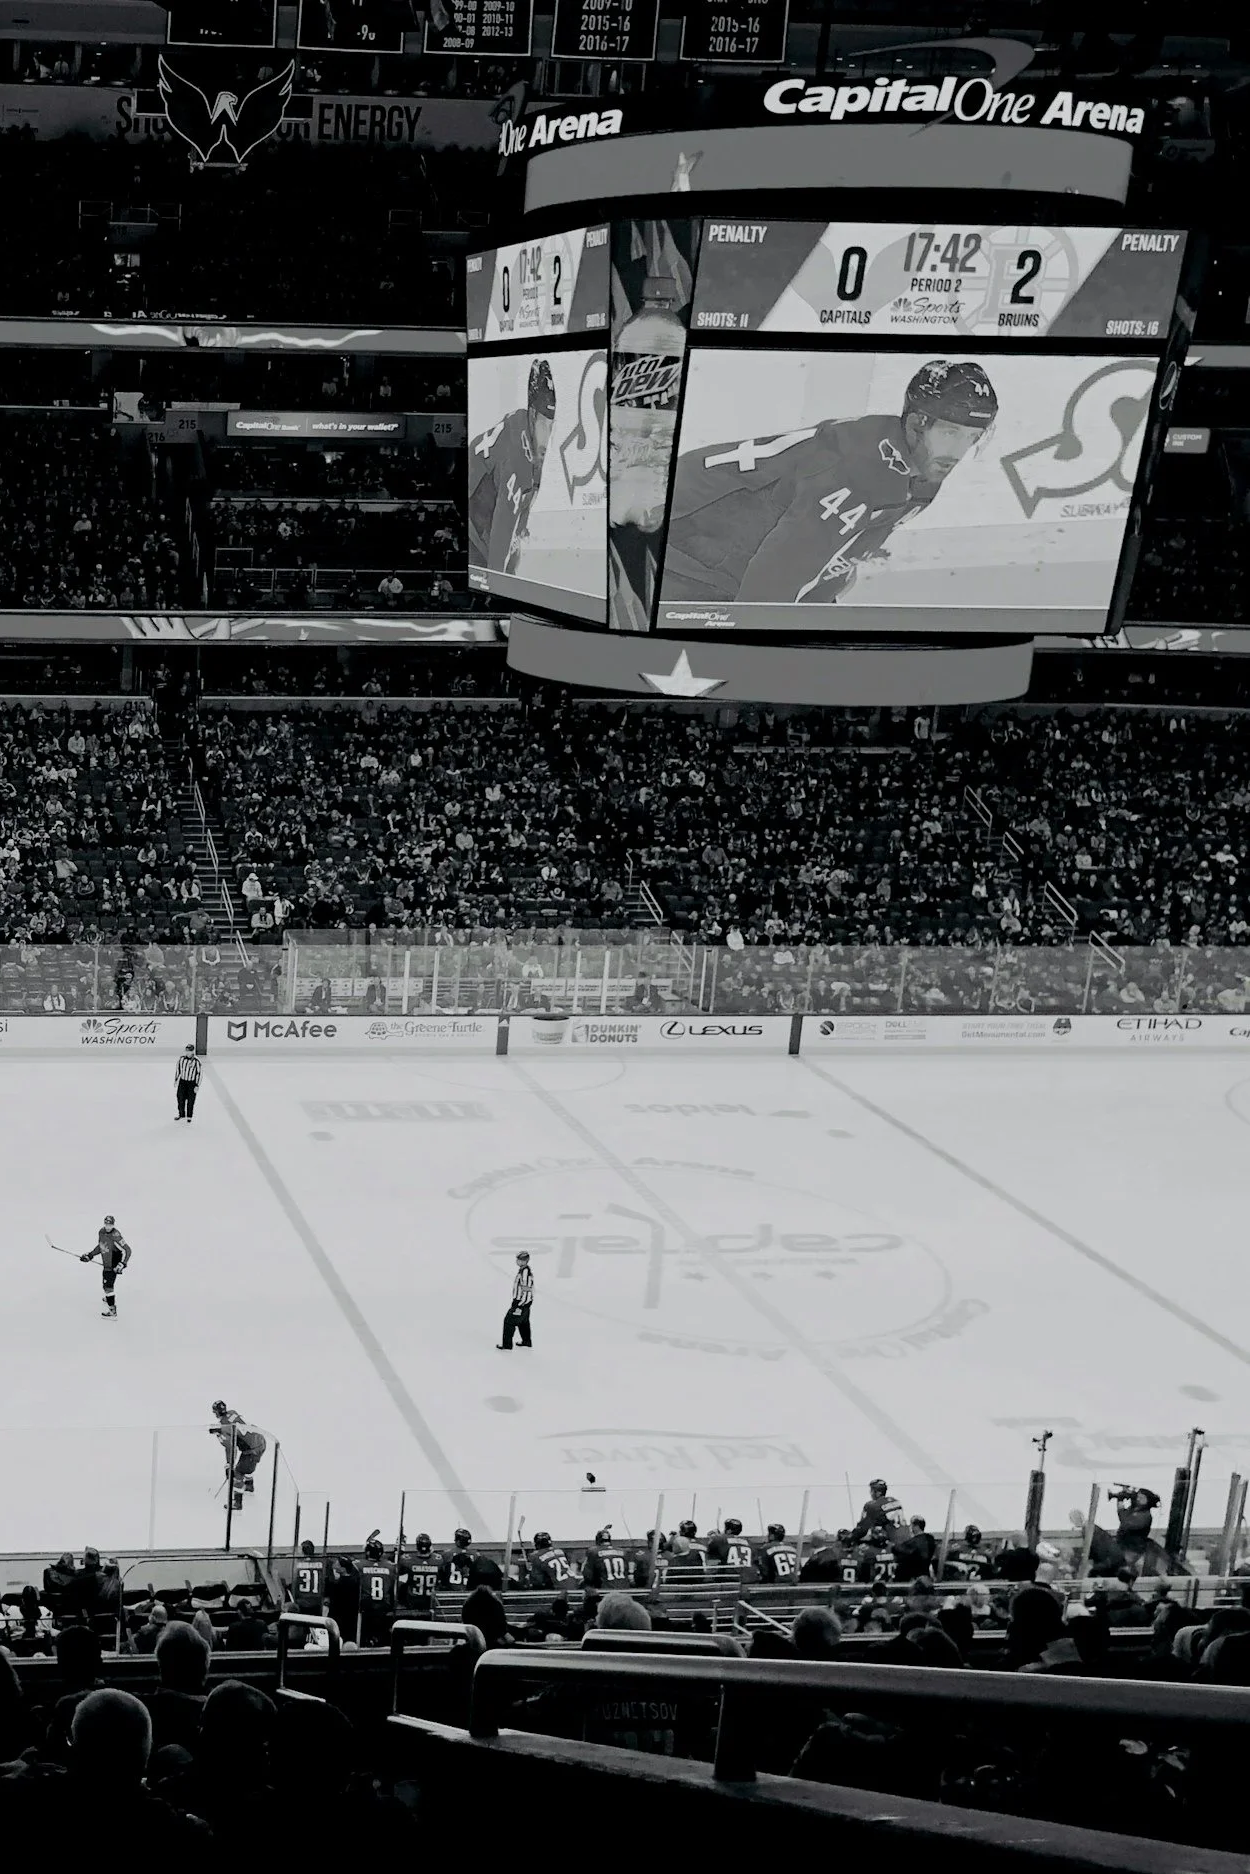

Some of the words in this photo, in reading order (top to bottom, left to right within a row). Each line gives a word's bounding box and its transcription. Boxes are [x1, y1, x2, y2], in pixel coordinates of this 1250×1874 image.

[483, 1, 515, 11] 2009-10
[454, 13, 476, 23] 00-01
[482, 13, 513, 24] 2010-11
[581, 14, 631, 31] 2015-16
[710, 16, 761, 34] 2015-16
[482, 26, 514, 37] 2012-13
[578, 35, 630, 52] 2016-17
[708, 36, 759, 53] 2016-17
[1040, 90, 1145, 134] Arena
[318, 103, 422, 142] ENERGY
[529, 107, 623, 147] Arena
[708, 225, 767, 244] PENALTY
[1121, 234, 1179, 253] PENALTY
[903, 232, 982, 273] 17:42
[553, 255, 562, 305] 2
[836, 246, 867, 302] 0
[1010, 250, 1042, 304] 2
[502, 266, 510, 312] 0
[910, 278, 950, 292] PERIOD
[953, 278, 962, 293] 2
[913, 297, 965, 314] Sports
[697, 311, 736, 328] SHOTS:
[819, 310, 871, 326] CAPITALS
[890, 315, 958, 325] WASHINGTON
[998, 312, 1039, 328] BRUINS
[1105, 319, 1146, 335] SHOTS:
[178, 420, 196, 429] 215
[434, 423, 452, 433] 215
[148, 432, 165, 442] 216
[818, 487, 868, 535] 44
[104, 1018, 163, 1035] Sports
[254, 1020, 338, 1038] McAfee
[390, 1022, 403, 1030] the
[404, 1021, 449, 1035] Greene
[449, 1021, 483, 1033] Turtle
[590, 1023, 642, 1033] DUNKIN'
[689, 1024, 763, 1035] LEXUS
[1116, 1018, 1202, 1030] ETIHAD
[81, 1036, 156, 1045] WASHINGTON
[590, 1033, 638, 1043] DONUTS
[1130, 1034, 1185, 1042] AIRWAYS
[559, 1444, 700, 1471] River
[704, 1442, 816, 1471] Red
[727, 1546, 751, 1567] 43
[604, 1558, 625, 1580] 10
[299, 1569, 319, 1594] 31
[371, 1576, 384, 1600] 8
[413, 1574, 437, 1596] 39
[602, 1702, 678, 1721] UZNETSOV
